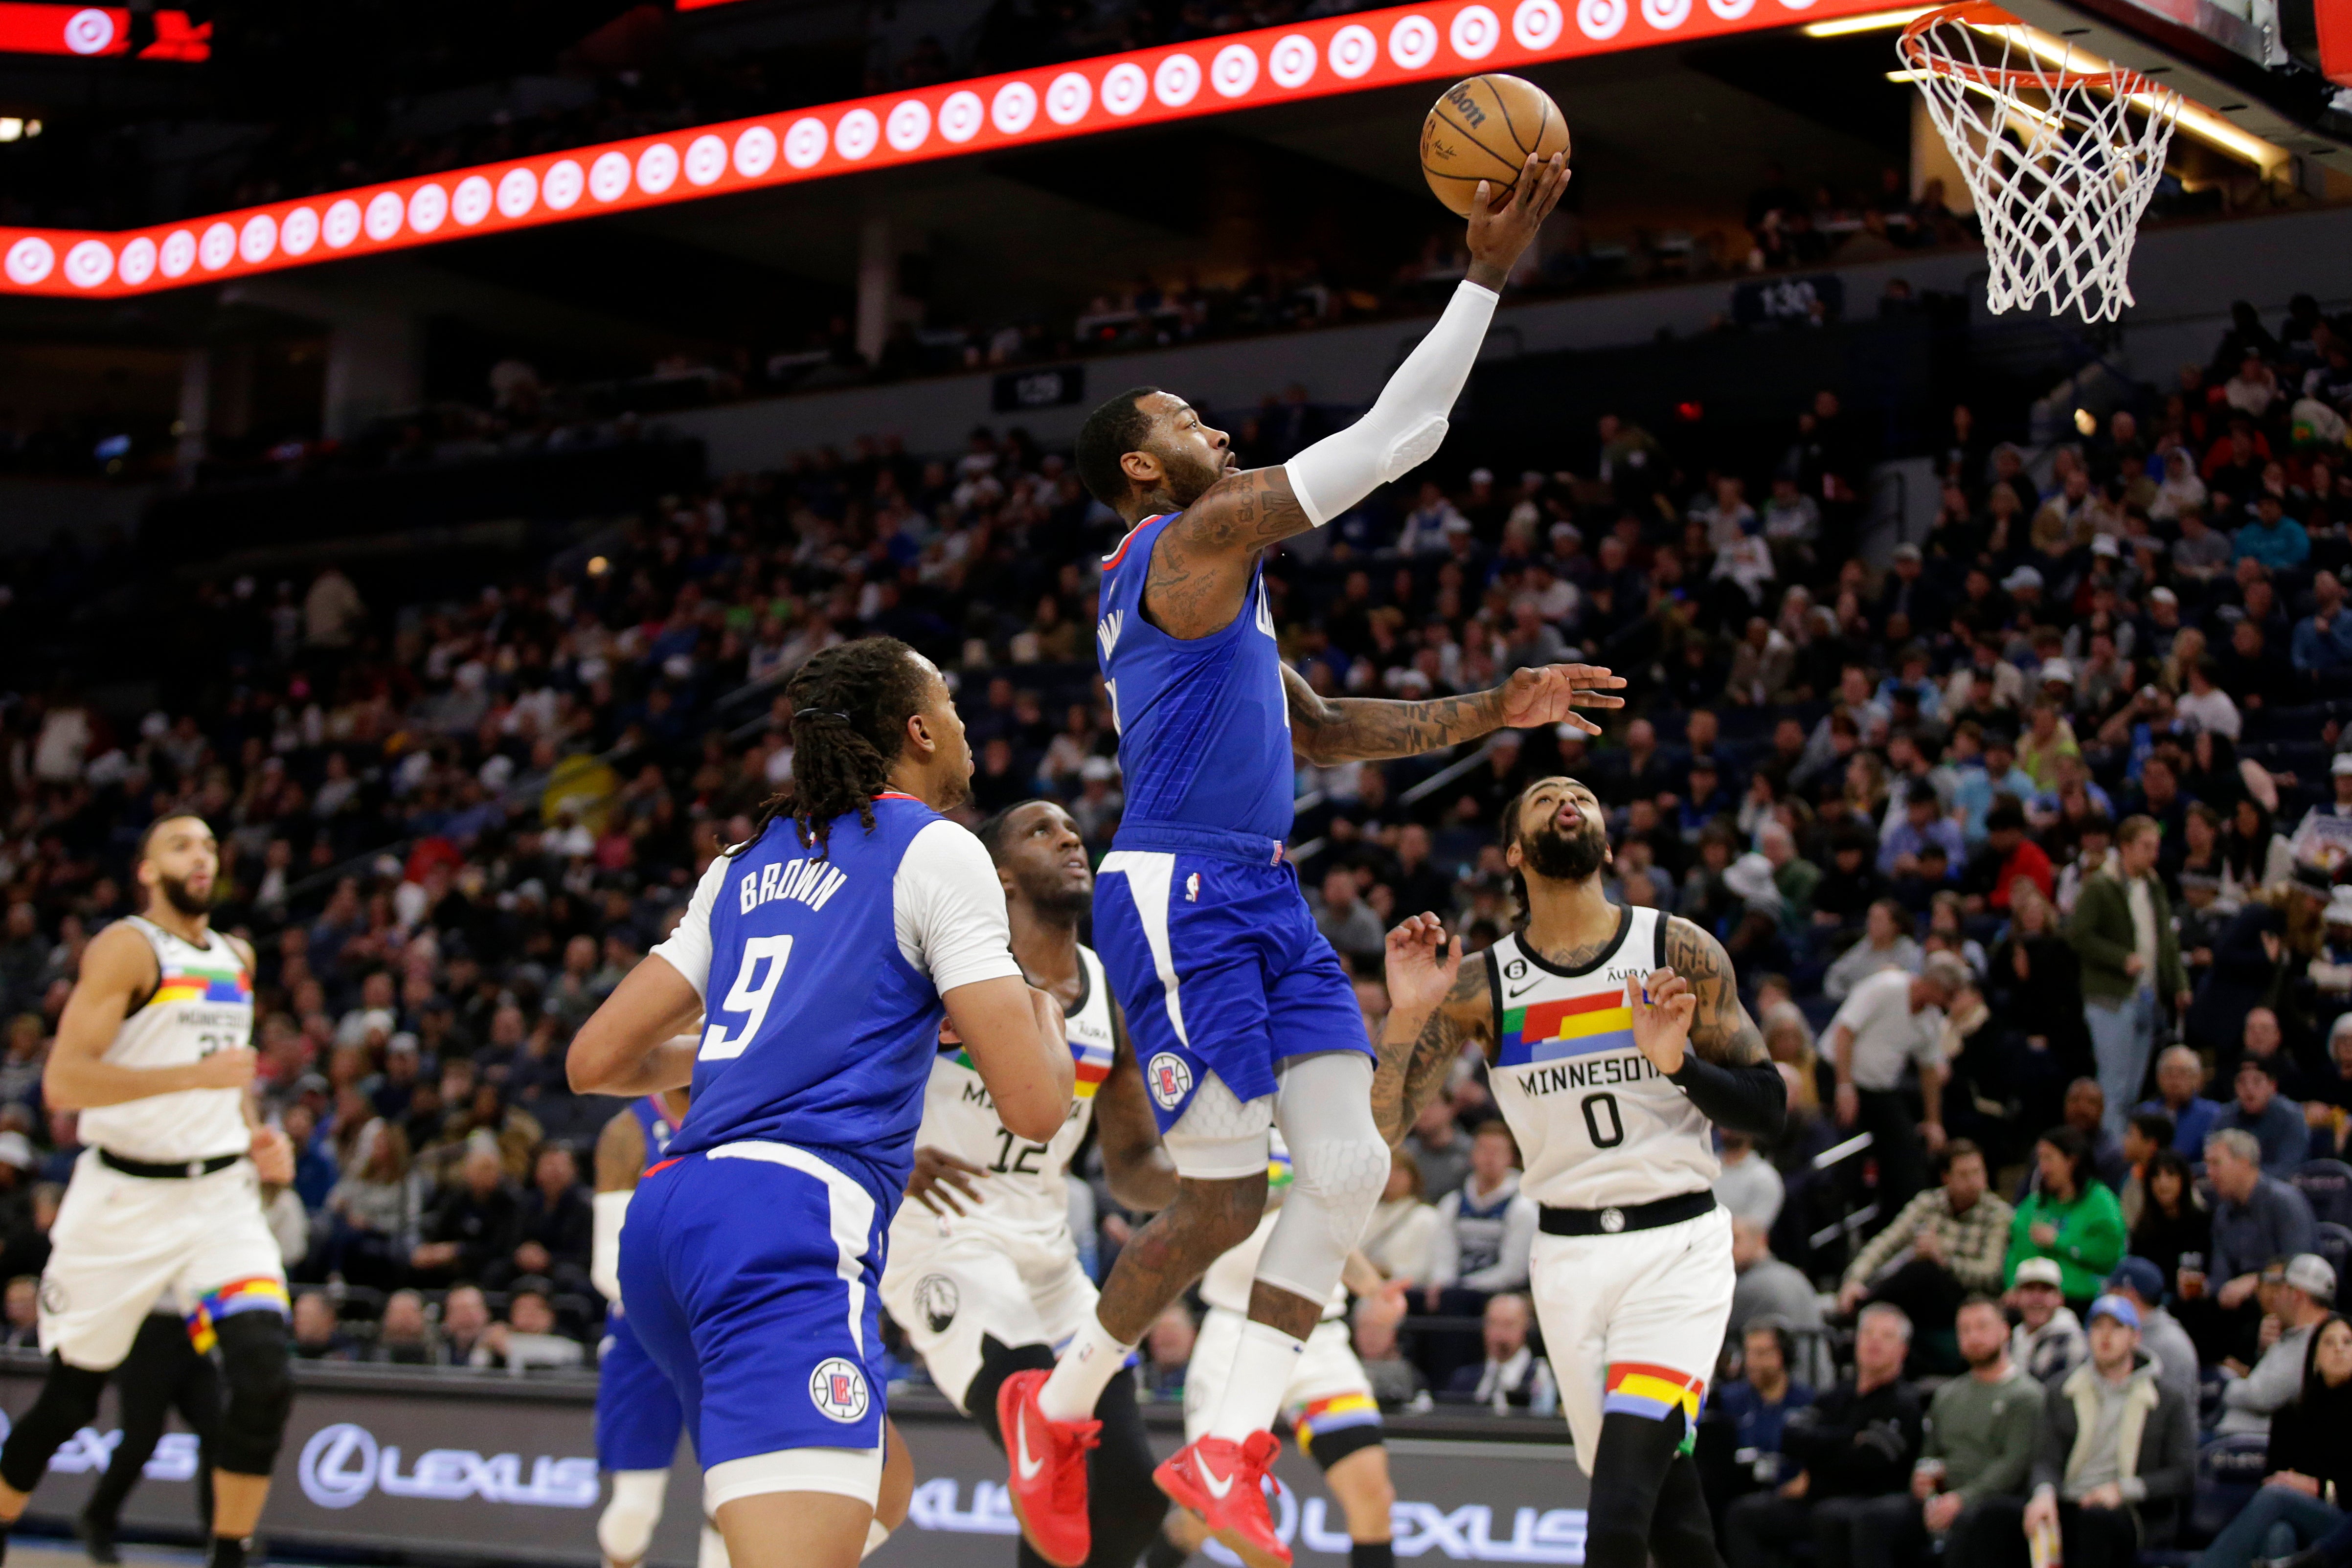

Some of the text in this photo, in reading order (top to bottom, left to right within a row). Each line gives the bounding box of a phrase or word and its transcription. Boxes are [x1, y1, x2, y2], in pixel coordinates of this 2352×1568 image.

[741, 857, 848, 915] BROWN
[698, 934, 793, 1062] 9
[1509, 961, 1524, 978] 6
[1581, 1092, 1624, 1149] 0
[987, 1129, 1048, 1174] 12
[47, 1426, 201, 1481] EXS
[377, 1445, 601, 1509] LEXUS
